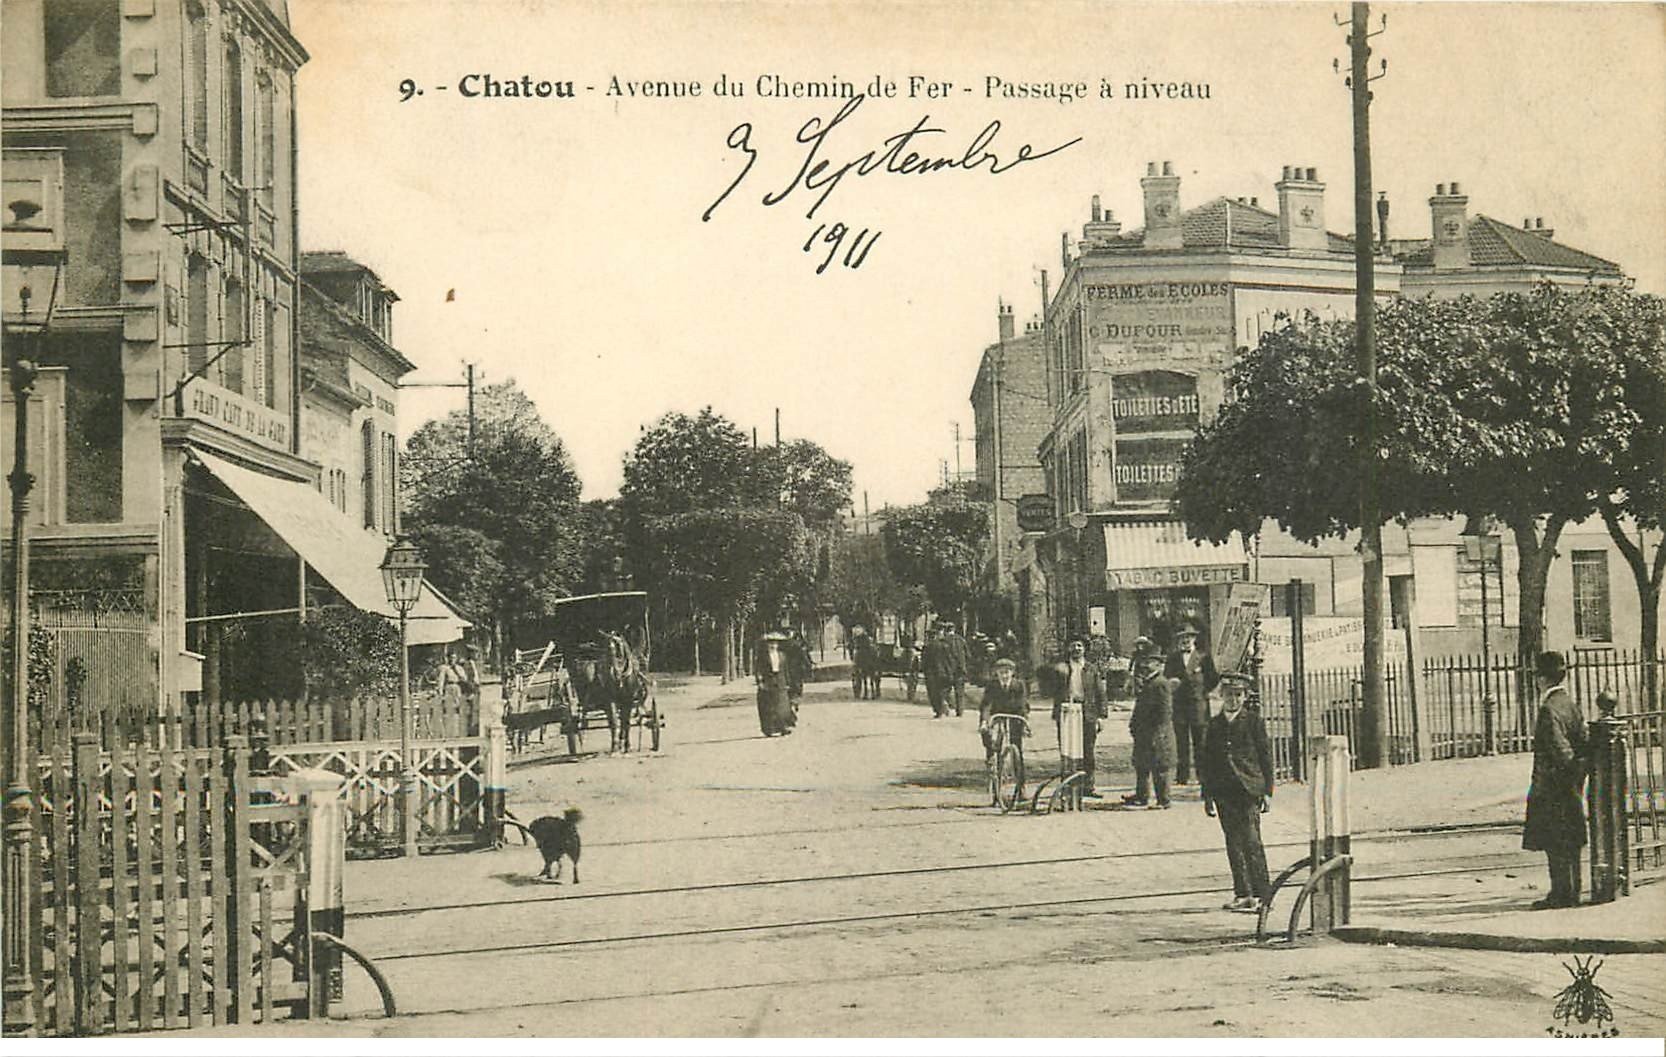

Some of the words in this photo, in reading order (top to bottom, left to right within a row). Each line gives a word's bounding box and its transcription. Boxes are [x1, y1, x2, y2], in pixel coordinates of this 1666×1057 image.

[762, 93, 1084, 220] Septembre
[803, 221, 882, 275] 1911
[1087, 284, 1146, 300] FERME
[1168, 282, 1229, 299] ECOLES
[1106, 324, 1183, 338] DUFOUR
[1113, 396, 1171, 417] TOILETTES
[1116, 464, 1174, 485] TOILETTES
[1169, 567, 1240, 586] BUVETTE
